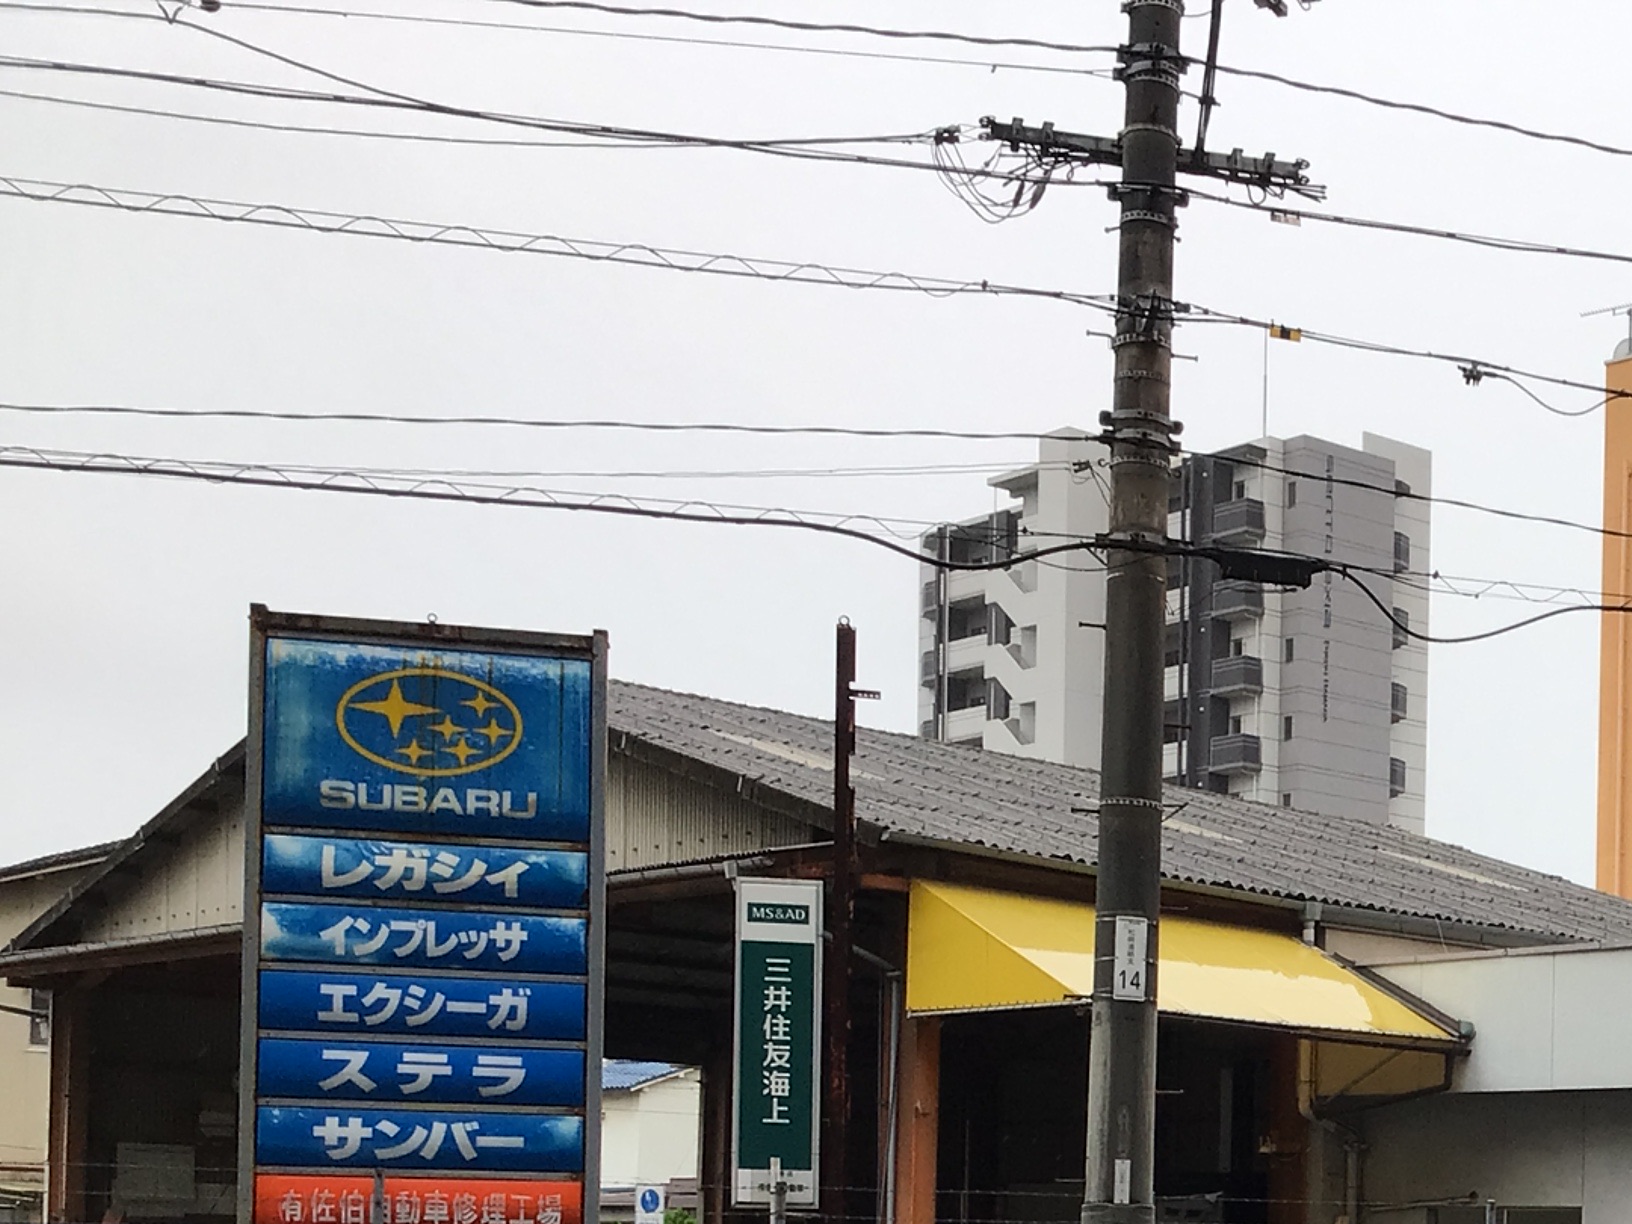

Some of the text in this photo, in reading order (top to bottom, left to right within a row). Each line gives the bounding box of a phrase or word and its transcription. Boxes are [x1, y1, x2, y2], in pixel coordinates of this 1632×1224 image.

[319, 780, 537, 819] SUBARU
[752, 907, 806, 920] MS&AD
[319, 915, 528, 961] インプレッサ
[1119, 969, 1141, 990] 14
[317, 981, 531, 1032] エクシーガ
[762, 957, 792, 1125] 三井住友海上
[318, 1048, 527, 1098] ステラ
[312, 1116, 525, 1162] サンバー
